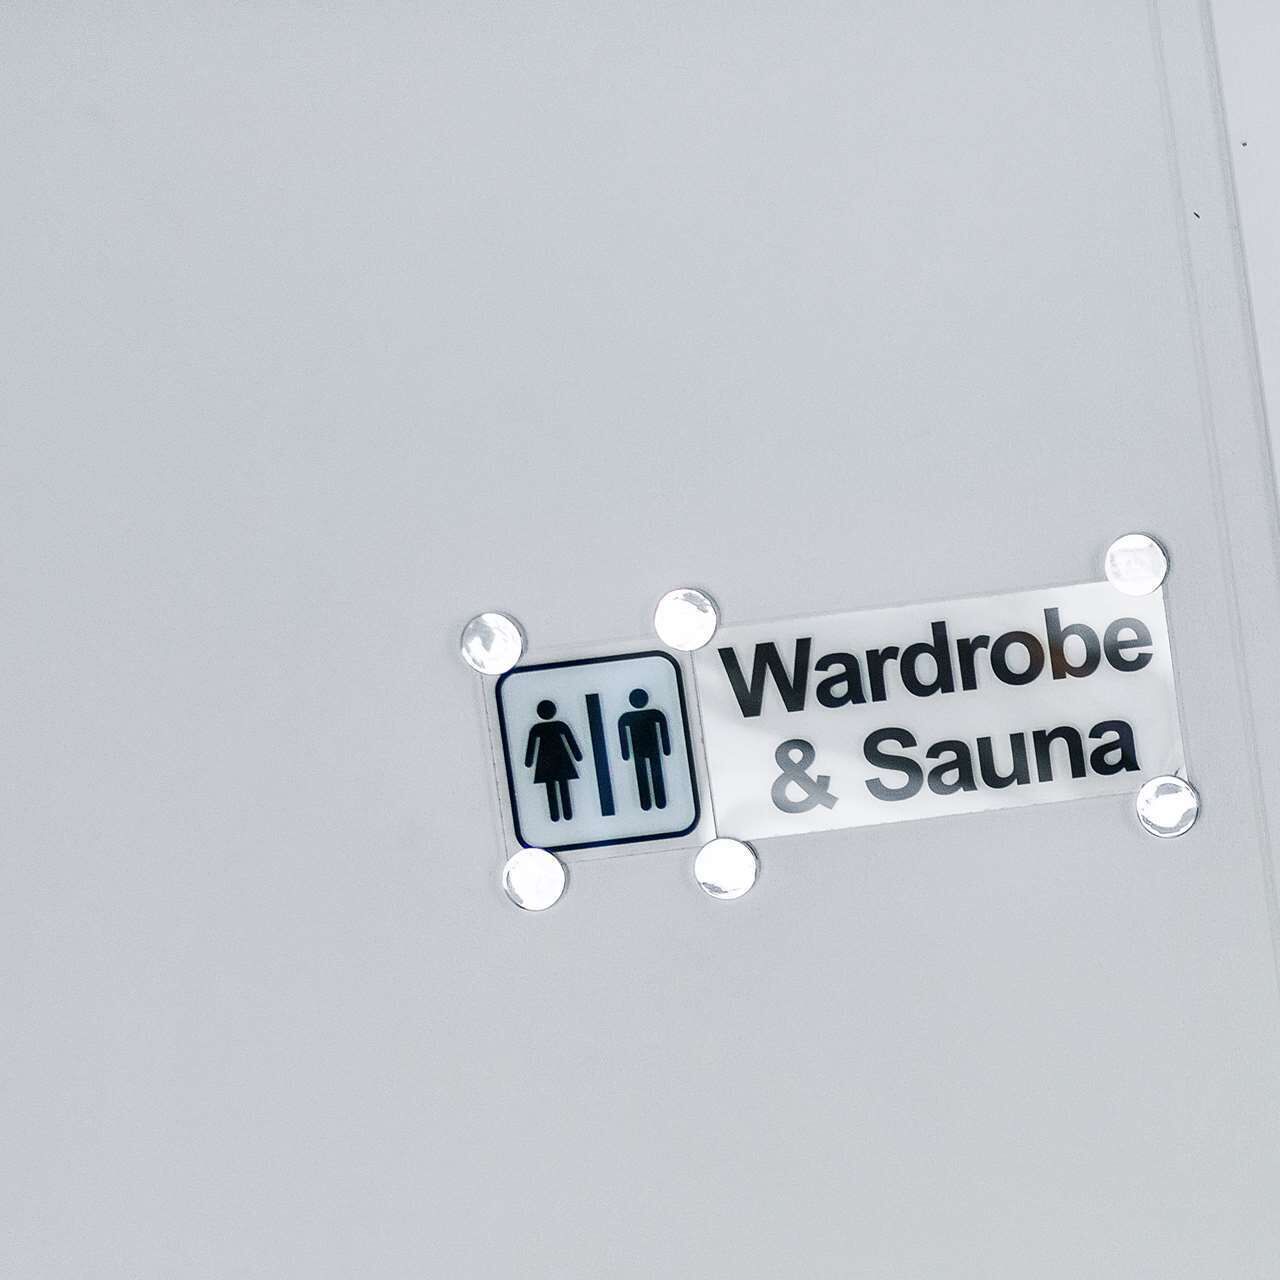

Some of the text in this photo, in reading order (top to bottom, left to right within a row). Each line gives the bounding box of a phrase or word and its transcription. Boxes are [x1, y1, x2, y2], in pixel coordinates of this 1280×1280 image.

[717, 607, 1153, 718] Wardrobe
[770, 717, 1140, 814] & Sauna
